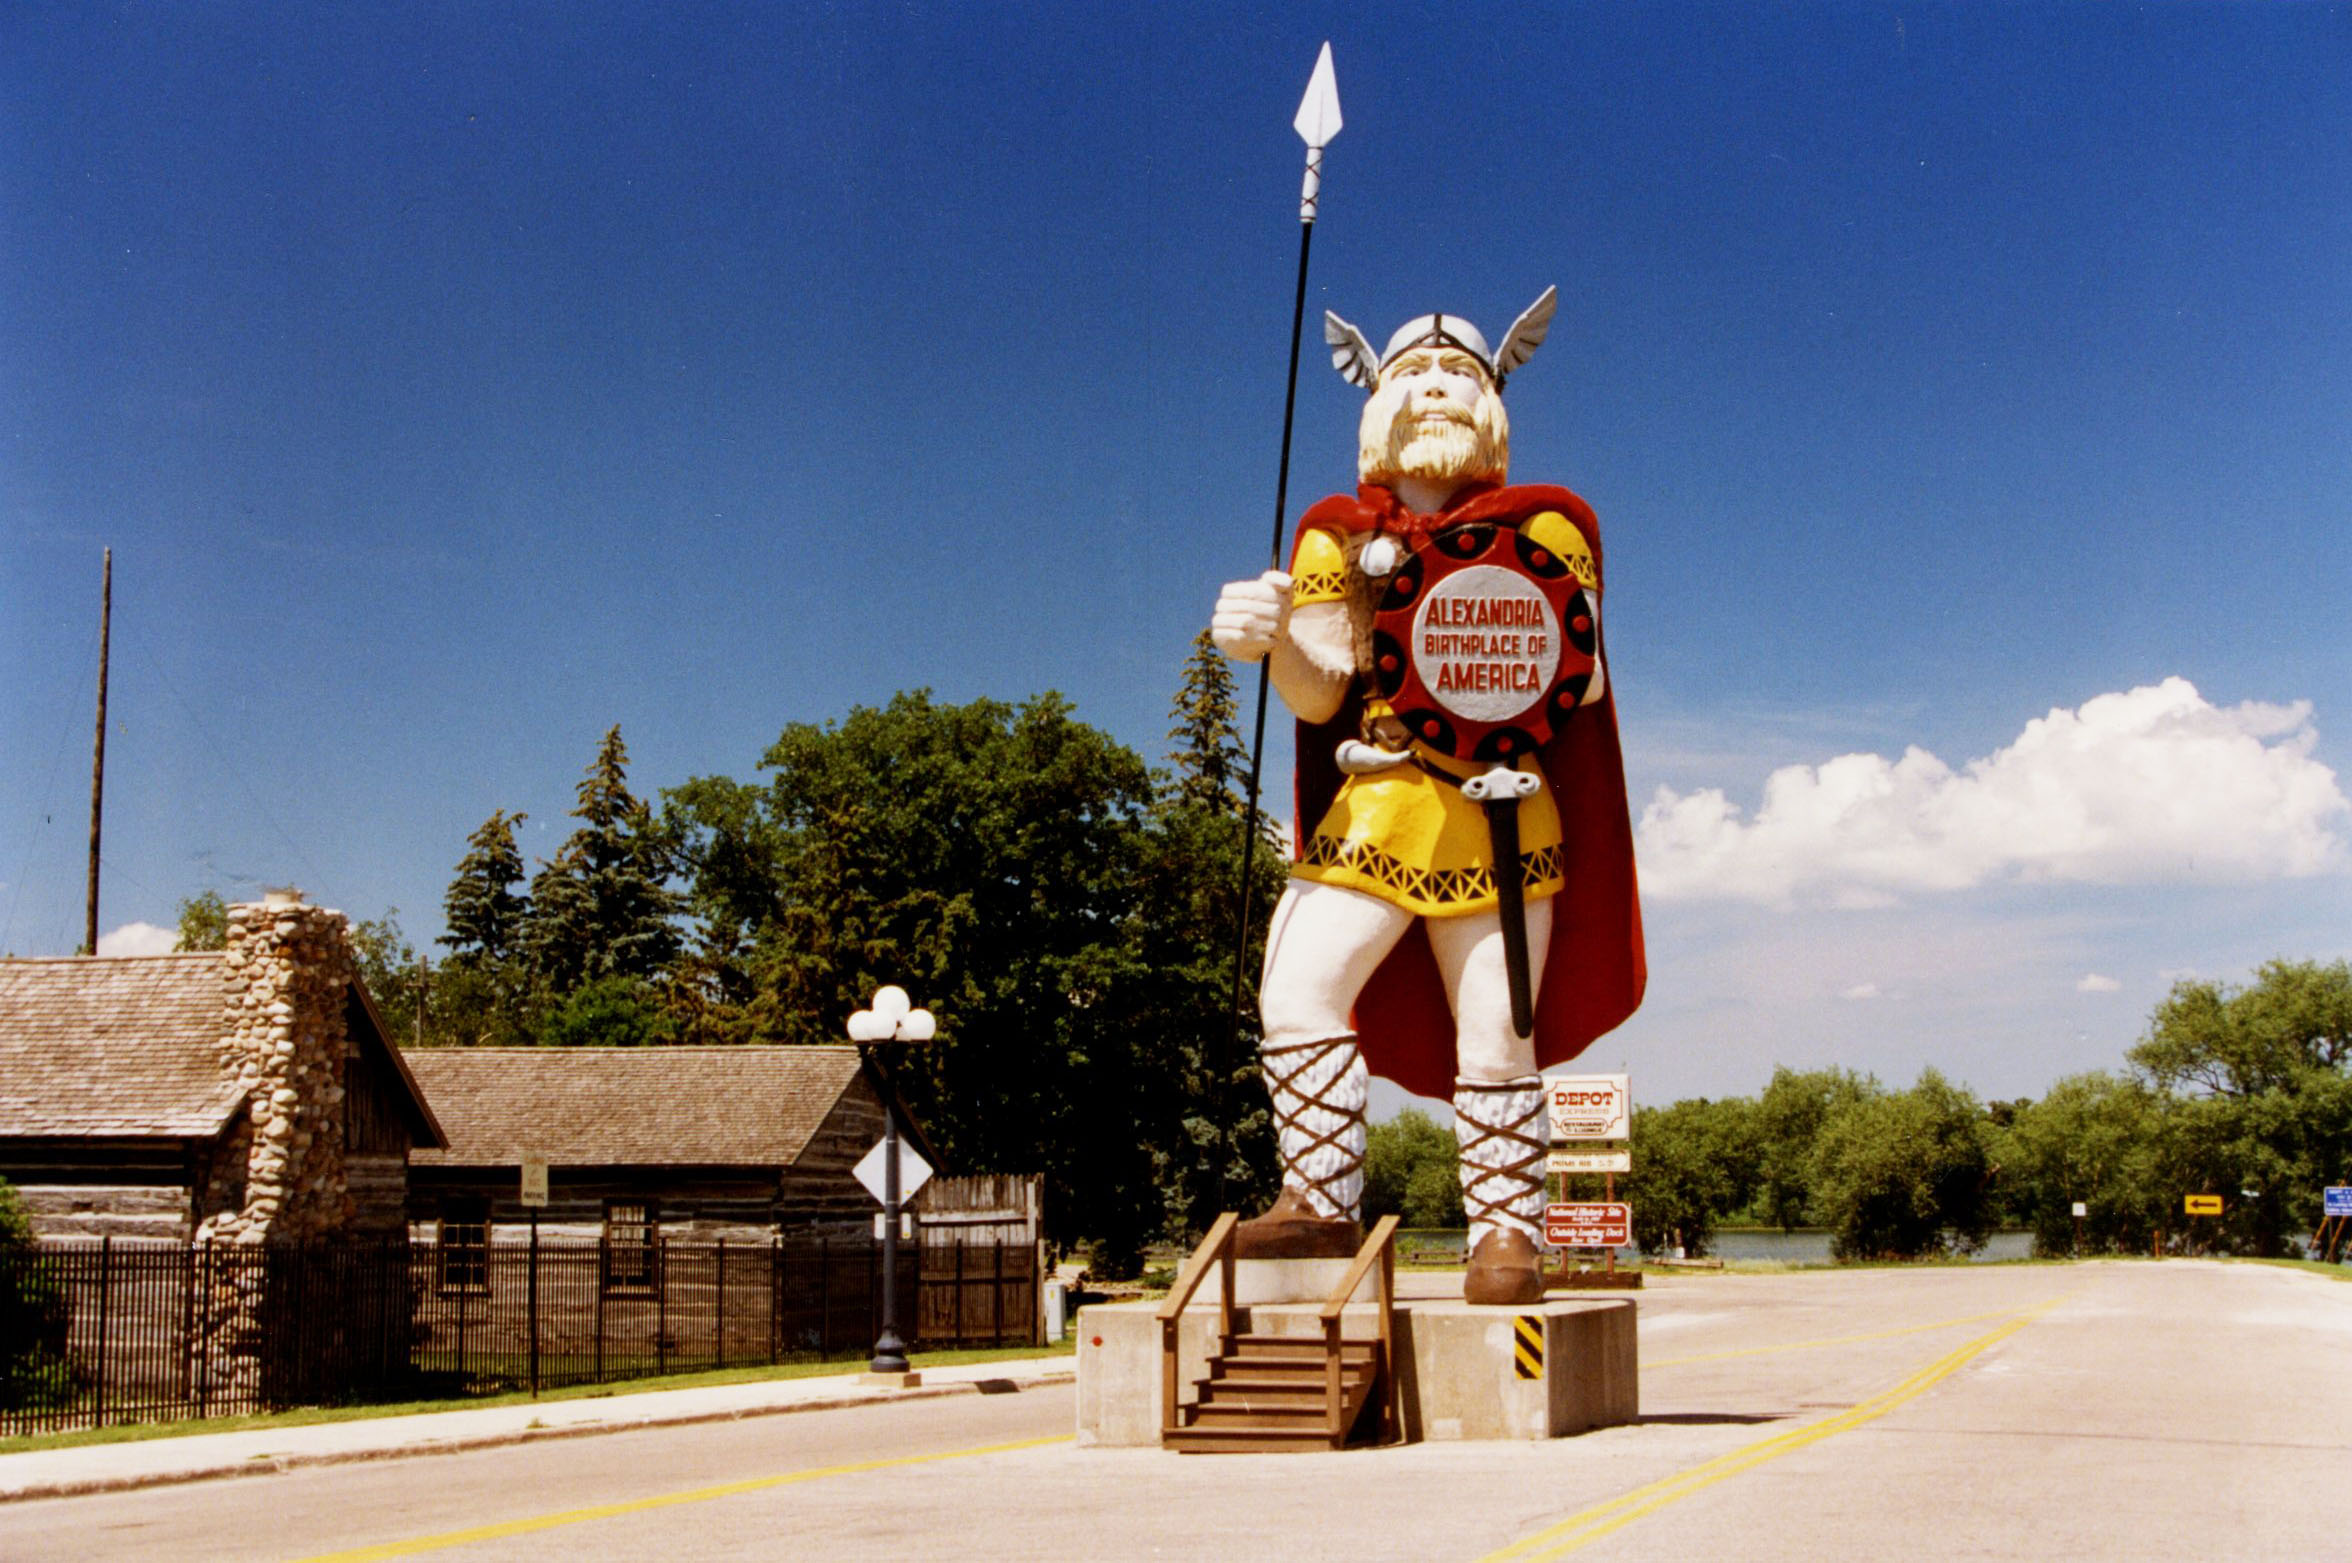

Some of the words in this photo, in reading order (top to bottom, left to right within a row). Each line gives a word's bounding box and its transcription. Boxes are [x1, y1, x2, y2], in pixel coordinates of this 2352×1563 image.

[1425, 597, 1544, 627] ALEXANDRIA
[1425, 634, 1520, 656] BIRTHPLACE
[1528, 635, 1547, 657] OF
[1437, 662, 1541, 692] AMERICA
[1555, 1092, 1613, 1106] DEPOT
